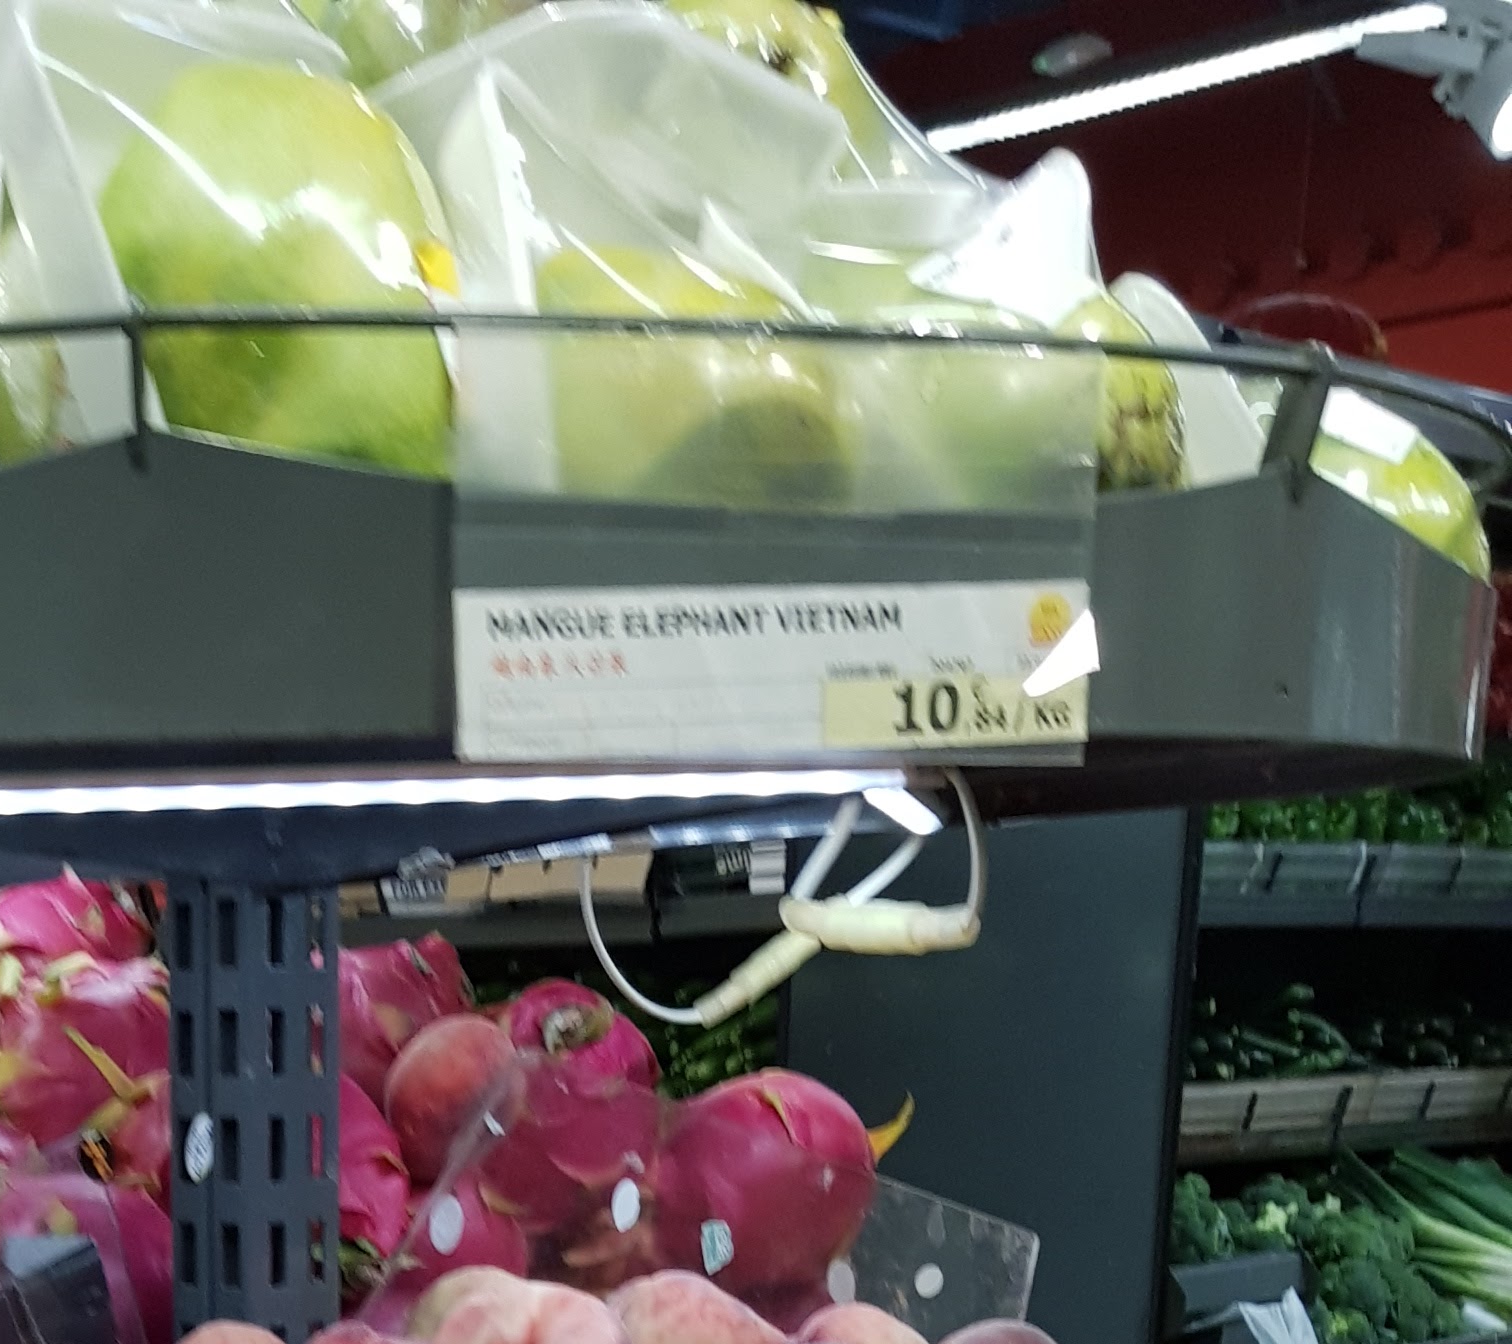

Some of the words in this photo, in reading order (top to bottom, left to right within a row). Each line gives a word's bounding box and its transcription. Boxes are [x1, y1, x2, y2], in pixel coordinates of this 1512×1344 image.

[487, 606, 615, 640] MANGUE
[621, 602, 770, 638] ELEPHANT
[774, 600, 902, 634] VIETNAM
